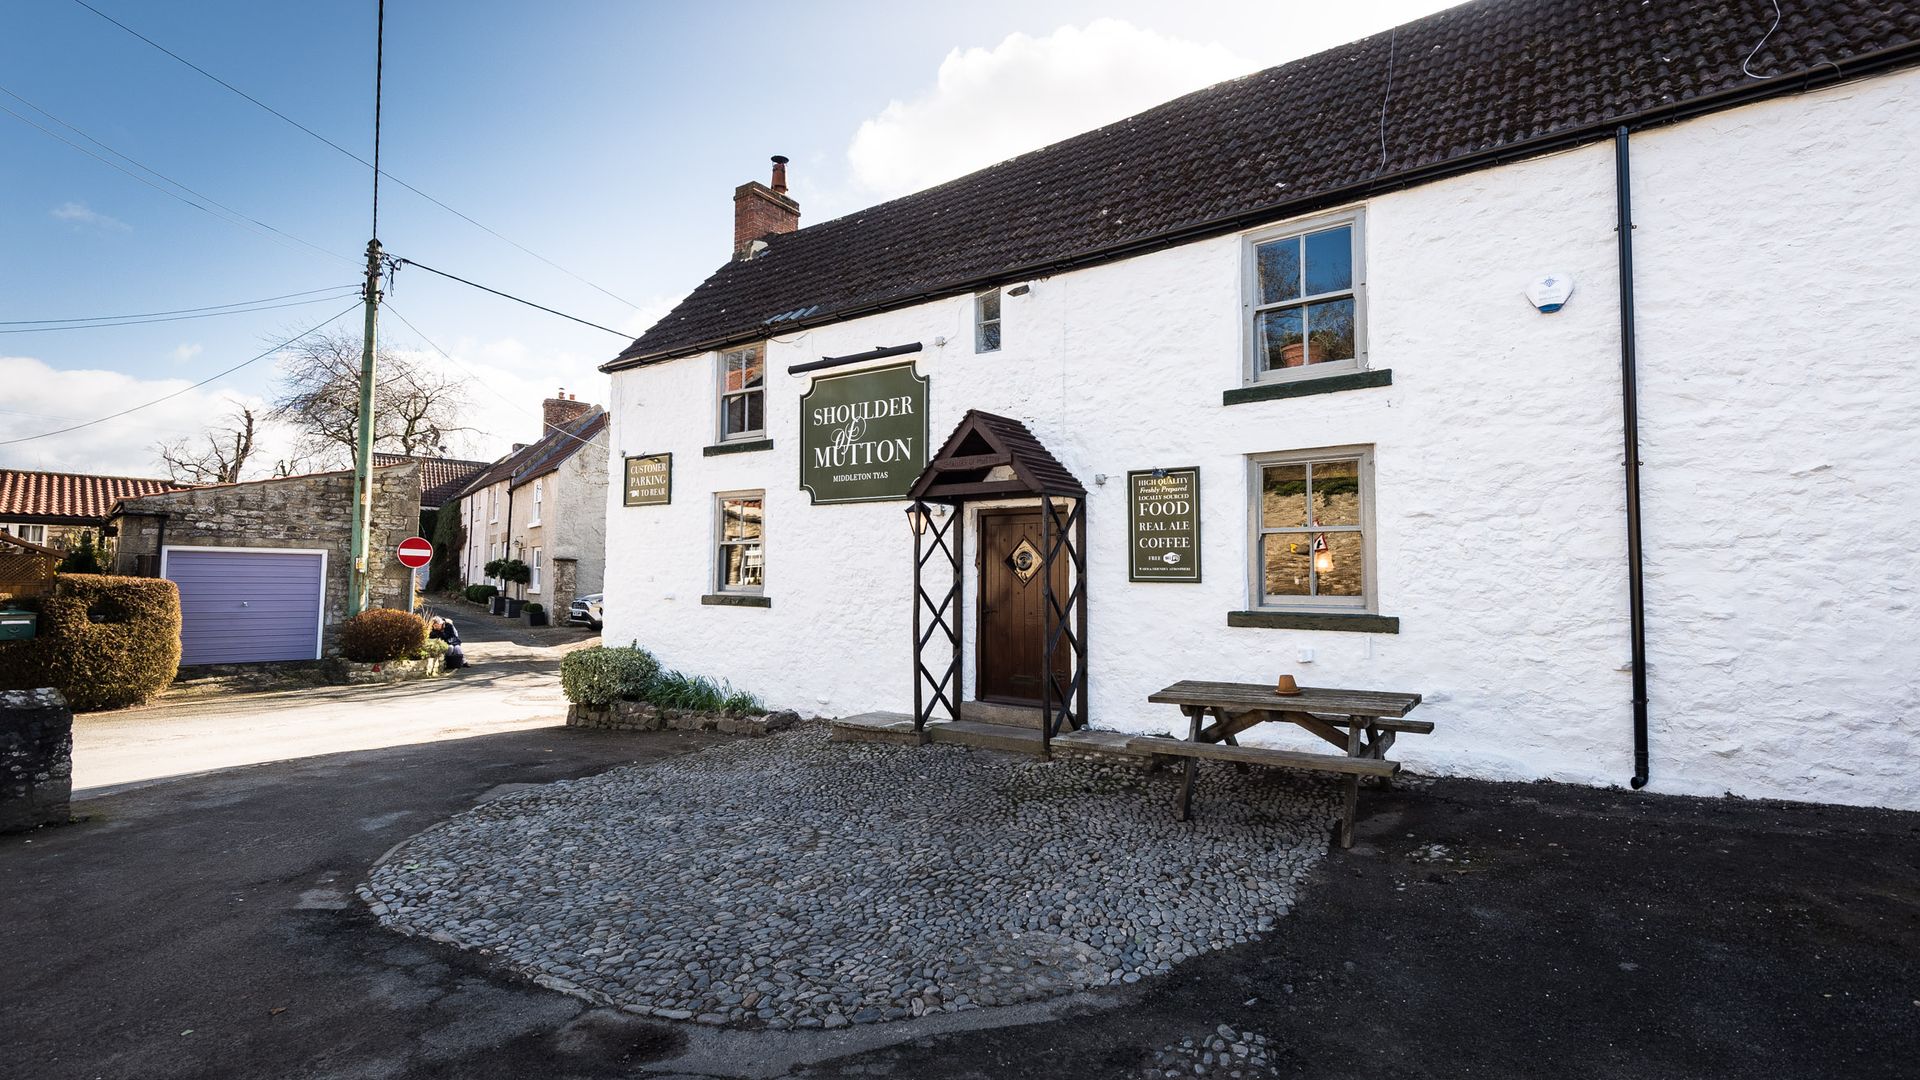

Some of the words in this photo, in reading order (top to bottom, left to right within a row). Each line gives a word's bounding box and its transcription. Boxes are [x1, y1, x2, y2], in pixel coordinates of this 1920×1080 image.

[813, 396, 914, 426] SHOULDER
[813, 437, 913, 469] MUTTON
[630, 463, 666, 474] CUSTOMER
[630, 475, 665, 486] PARKING
[832, 472, 872, 483] MIDDLETON
[872, 471, 889, 479] TYAS
[1138, 479, 1157, 487] HIGH
[1157, 477, 1189, 486] QUALITY
[649, 488, 665, 496] REAR
[1139, 486, 1160, 494] Freshly
[1160, 485, 1188, 493] Prepared
[1139, 501, 1190, 516] FOOD
[1139, 521, 1167, 531] REAL
[1169, 520, 1190, 531] ALE
[1139, 536, 1191, 549] COFFEE
